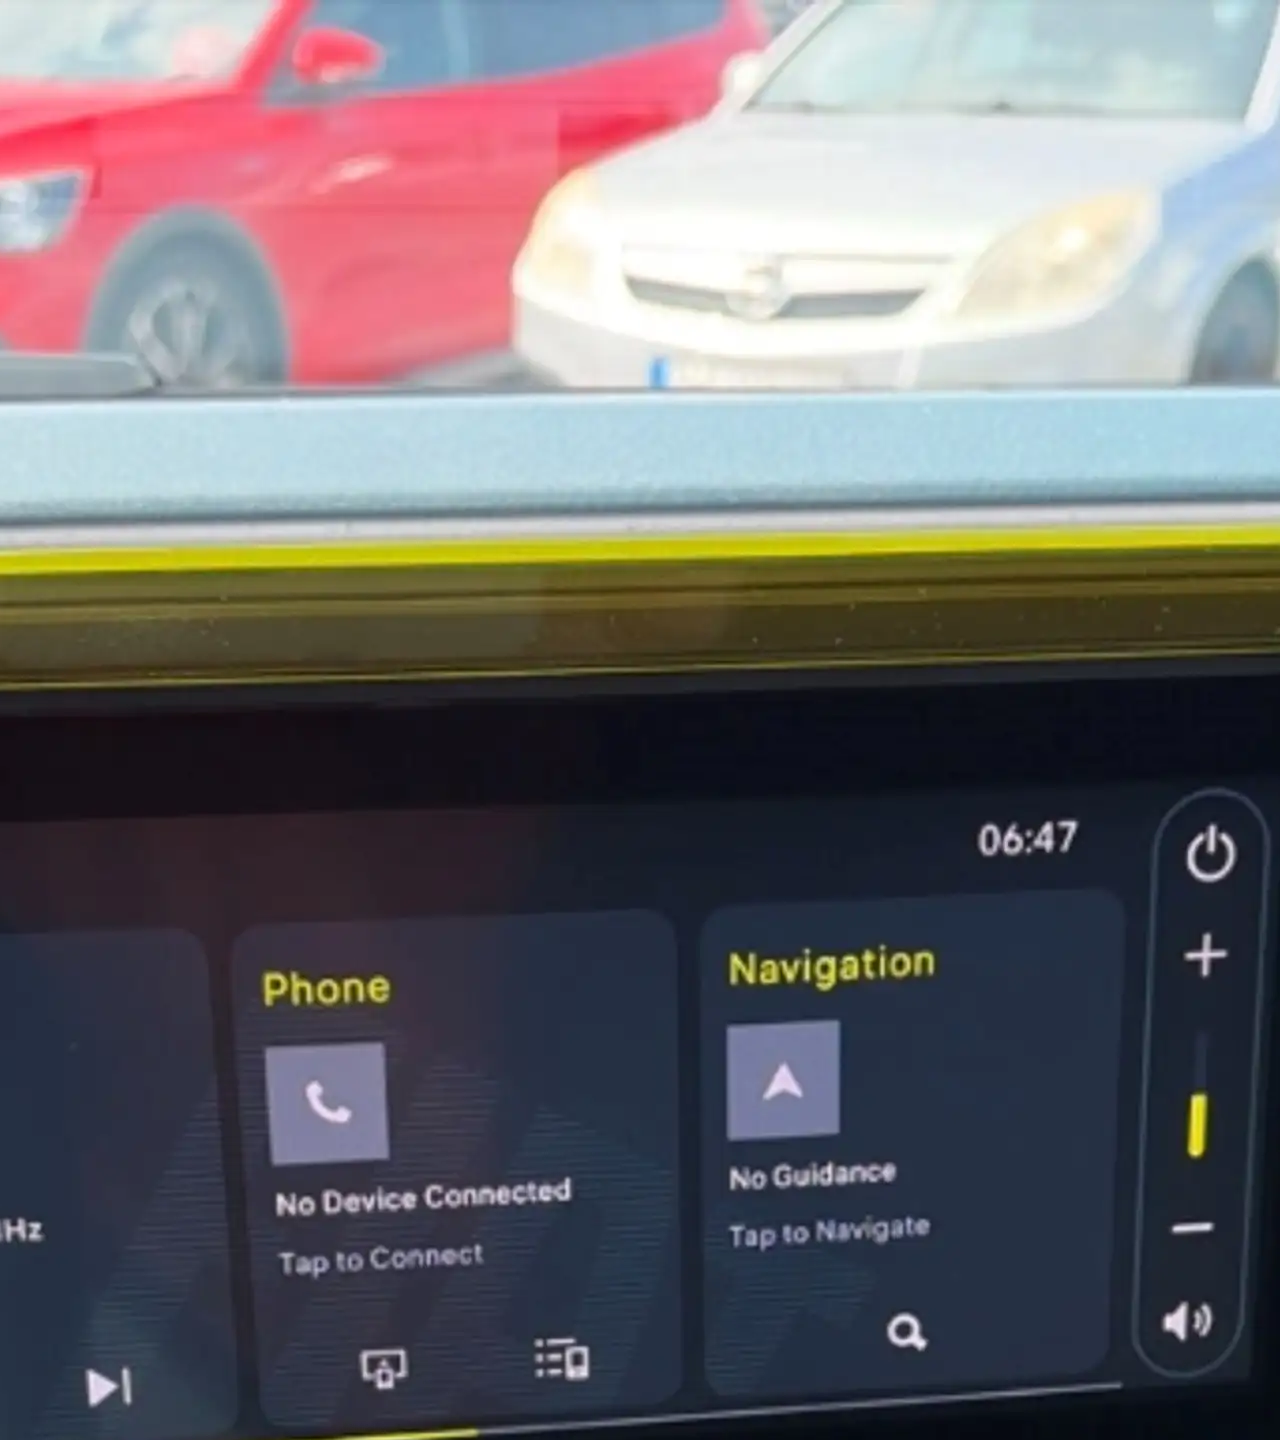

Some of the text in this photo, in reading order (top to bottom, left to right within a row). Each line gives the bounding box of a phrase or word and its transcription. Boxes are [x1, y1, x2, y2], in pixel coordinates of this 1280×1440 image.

[978, 820, 1078, 856] 06:47
[728, 945, 935, 990] Navigation
[263, 971, 392, 1006] Phone
[729, 1161, 897, 1191] No Guidance
[276, 1177, 572, 1217] No Device Connected
[729, 1215, 931, 1252] Tap to Navigate
[279, 1244, 484, 1278] Tap to Connect
